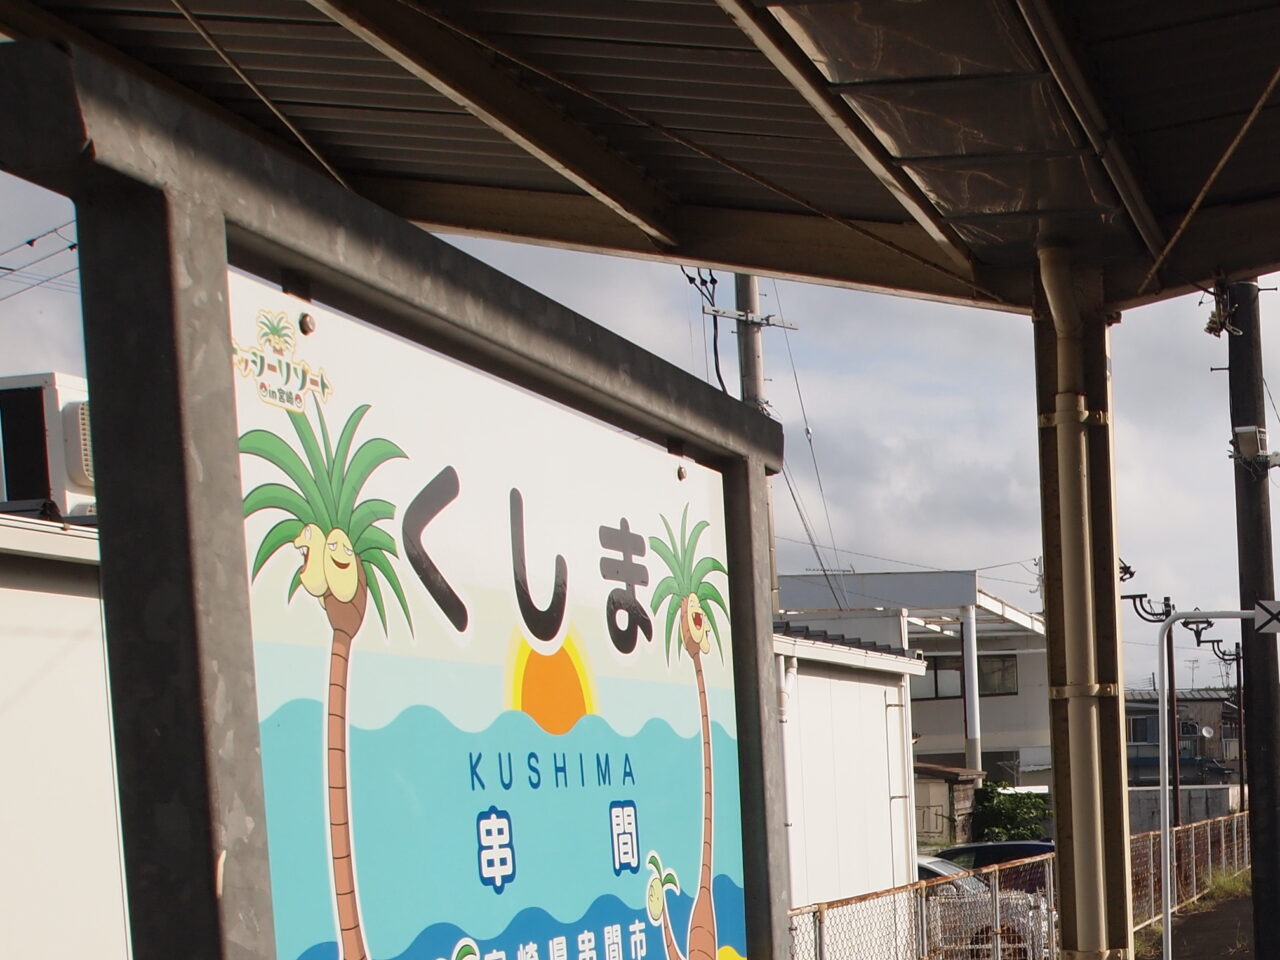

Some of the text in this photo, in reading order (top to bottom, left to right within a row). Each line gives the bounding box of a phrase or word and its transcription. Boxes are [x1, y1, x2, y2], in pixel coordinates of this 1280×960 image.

[232, 347, 330, 399] ッシーリゾート
[402, 465, 653, 654] くしま
[468, 752, 636, 791] KUSHIMA
[478, 802, 639, 888] 串間
